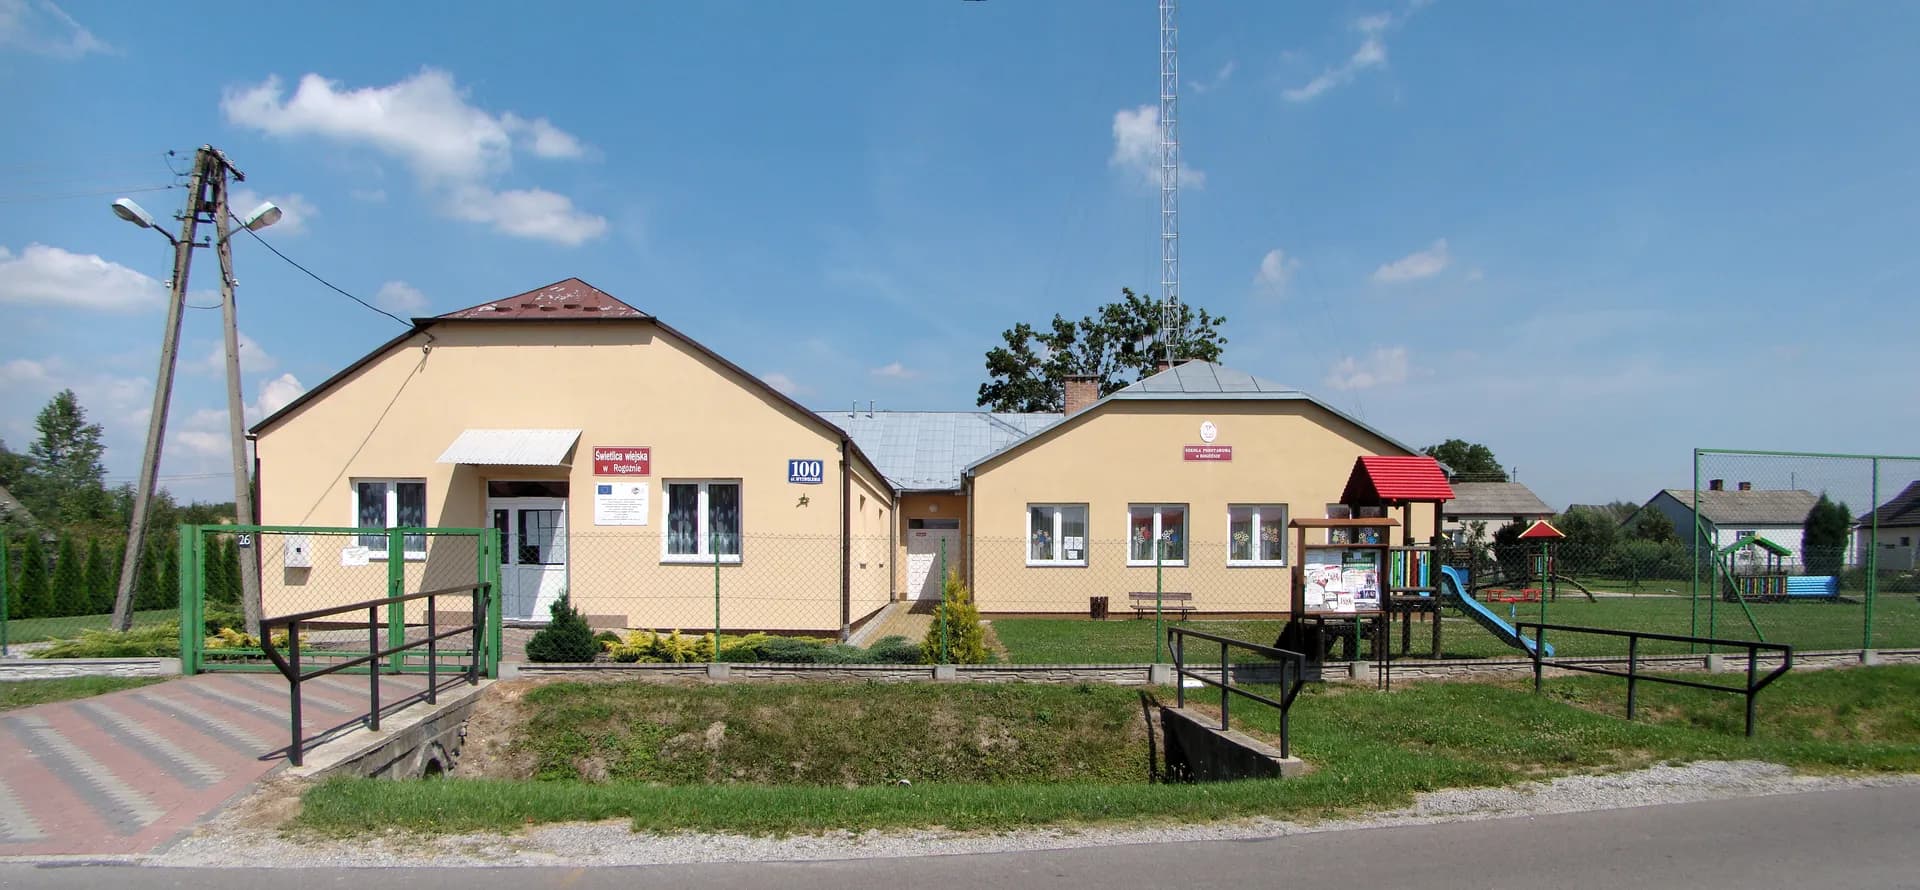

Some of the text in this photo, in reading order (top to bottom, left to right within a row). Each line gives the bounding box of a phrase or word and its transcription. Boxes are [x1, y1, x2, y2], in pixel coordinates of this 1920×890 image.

[596, 449, 647, 463] Świetlica wiejska
[602, 465, 608, 473] w
[791, 461, 820, 477] 100
[238, 534, 250, 545] 26
